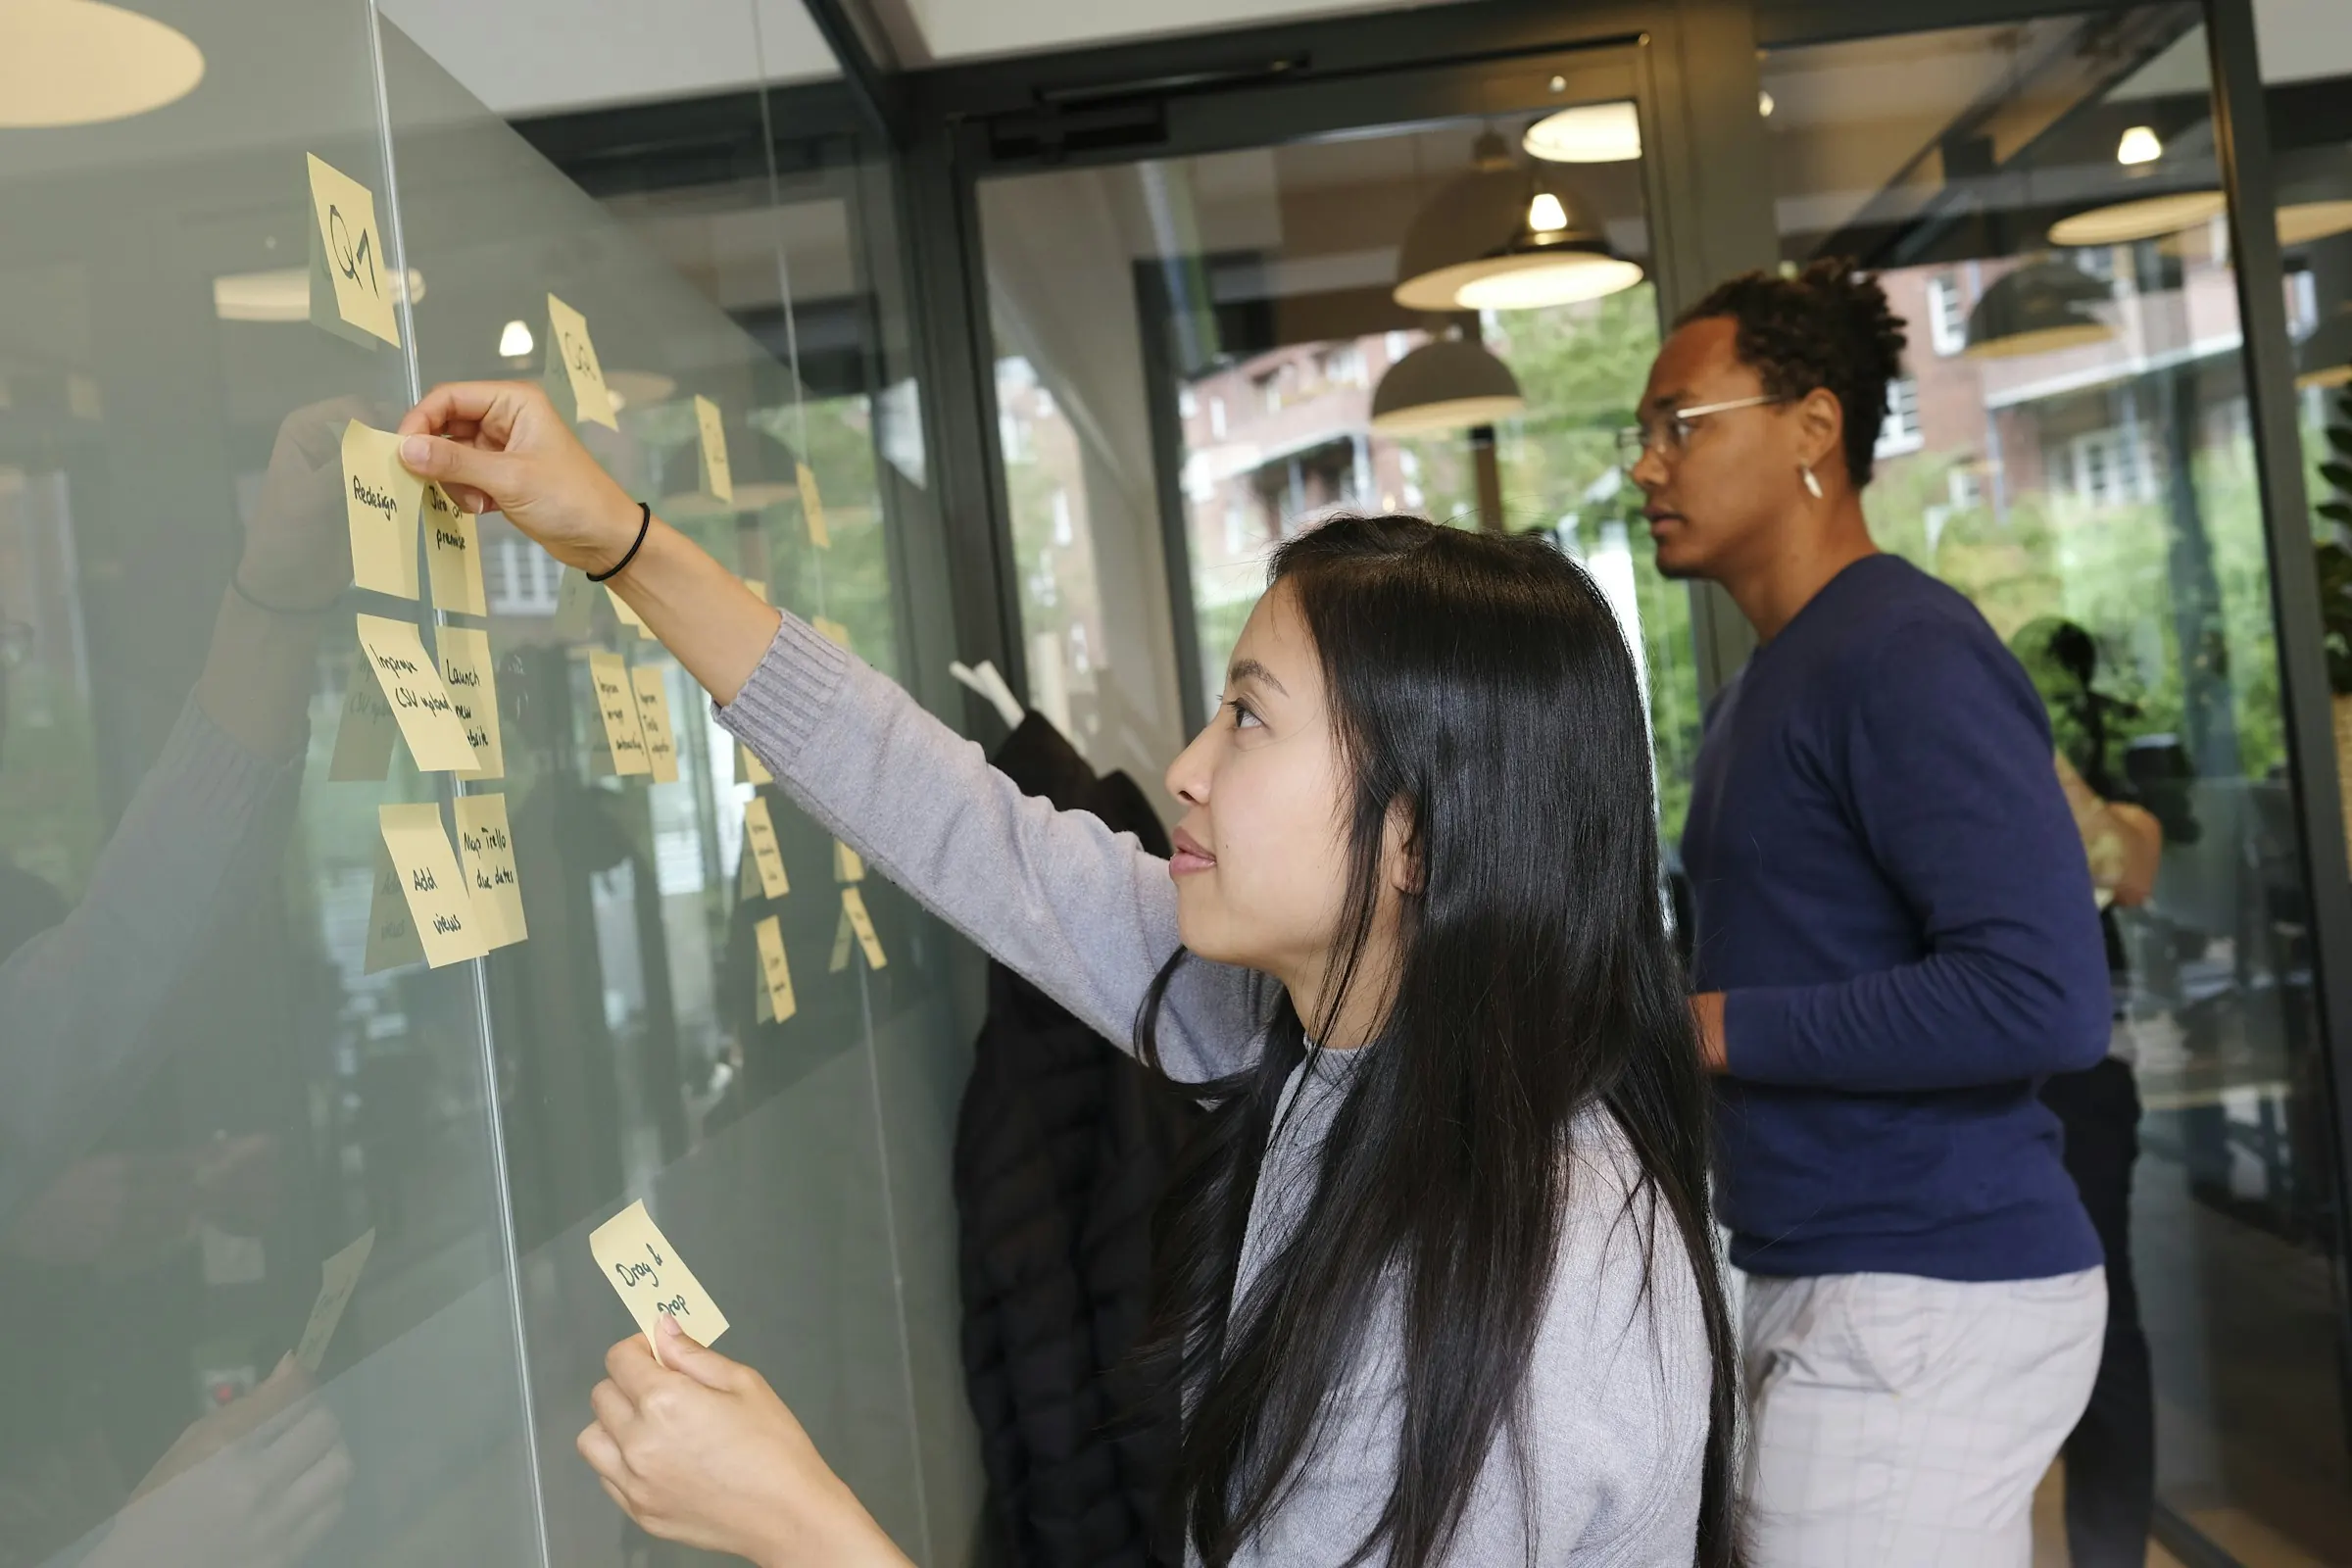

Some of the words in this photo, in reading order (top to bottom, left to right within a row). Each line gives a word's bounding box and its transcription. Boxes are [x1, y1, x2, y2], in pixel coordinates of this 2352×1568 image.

[328, 203, 380, 301] Q1
[353, 474, 398, 521] Redesign
[436, 528, 466, 551] premise
[368, 643, 418, 679] Improve
[446, 659, 481, 687] Launch
[395, 686, 418, 709] CSV
[419, 690, 454, 718] upload
[464, 832, 483, 859] Map
[481, 826, 507, 853] Trello
[412, 866, 439, 892] Add
[476, 868, 493, 890] due
[494, 865, 514, 886] dates
[432, 912, 463, 935] views
[615, 1262, 660, 1288] Drag
